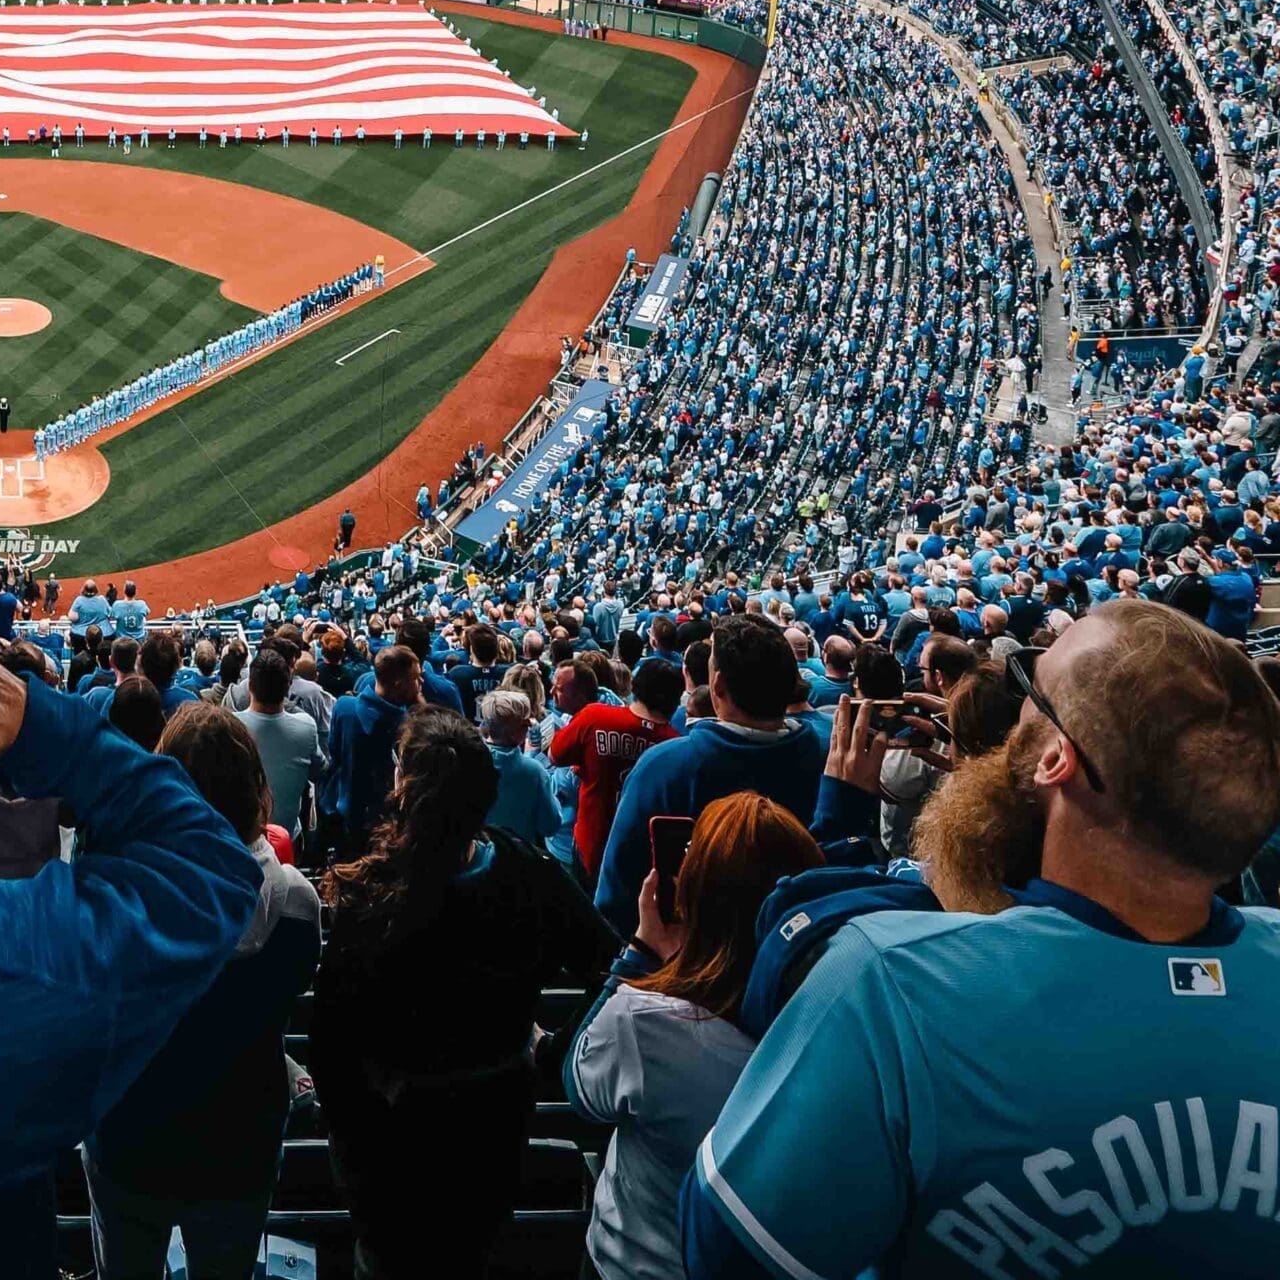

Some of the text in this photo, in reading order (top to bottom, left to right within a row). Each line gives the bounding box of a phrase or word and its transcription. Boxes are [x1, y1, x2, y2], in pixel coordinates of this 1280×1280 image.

[512, 442, 568, 500] HOME OF THE
[40, 540, 80, 553] DAY
[124, 616, 136, 628] 13
[864, 614, 878, 630] 13
[925, 1096, 1280, 1280] PASQUA
